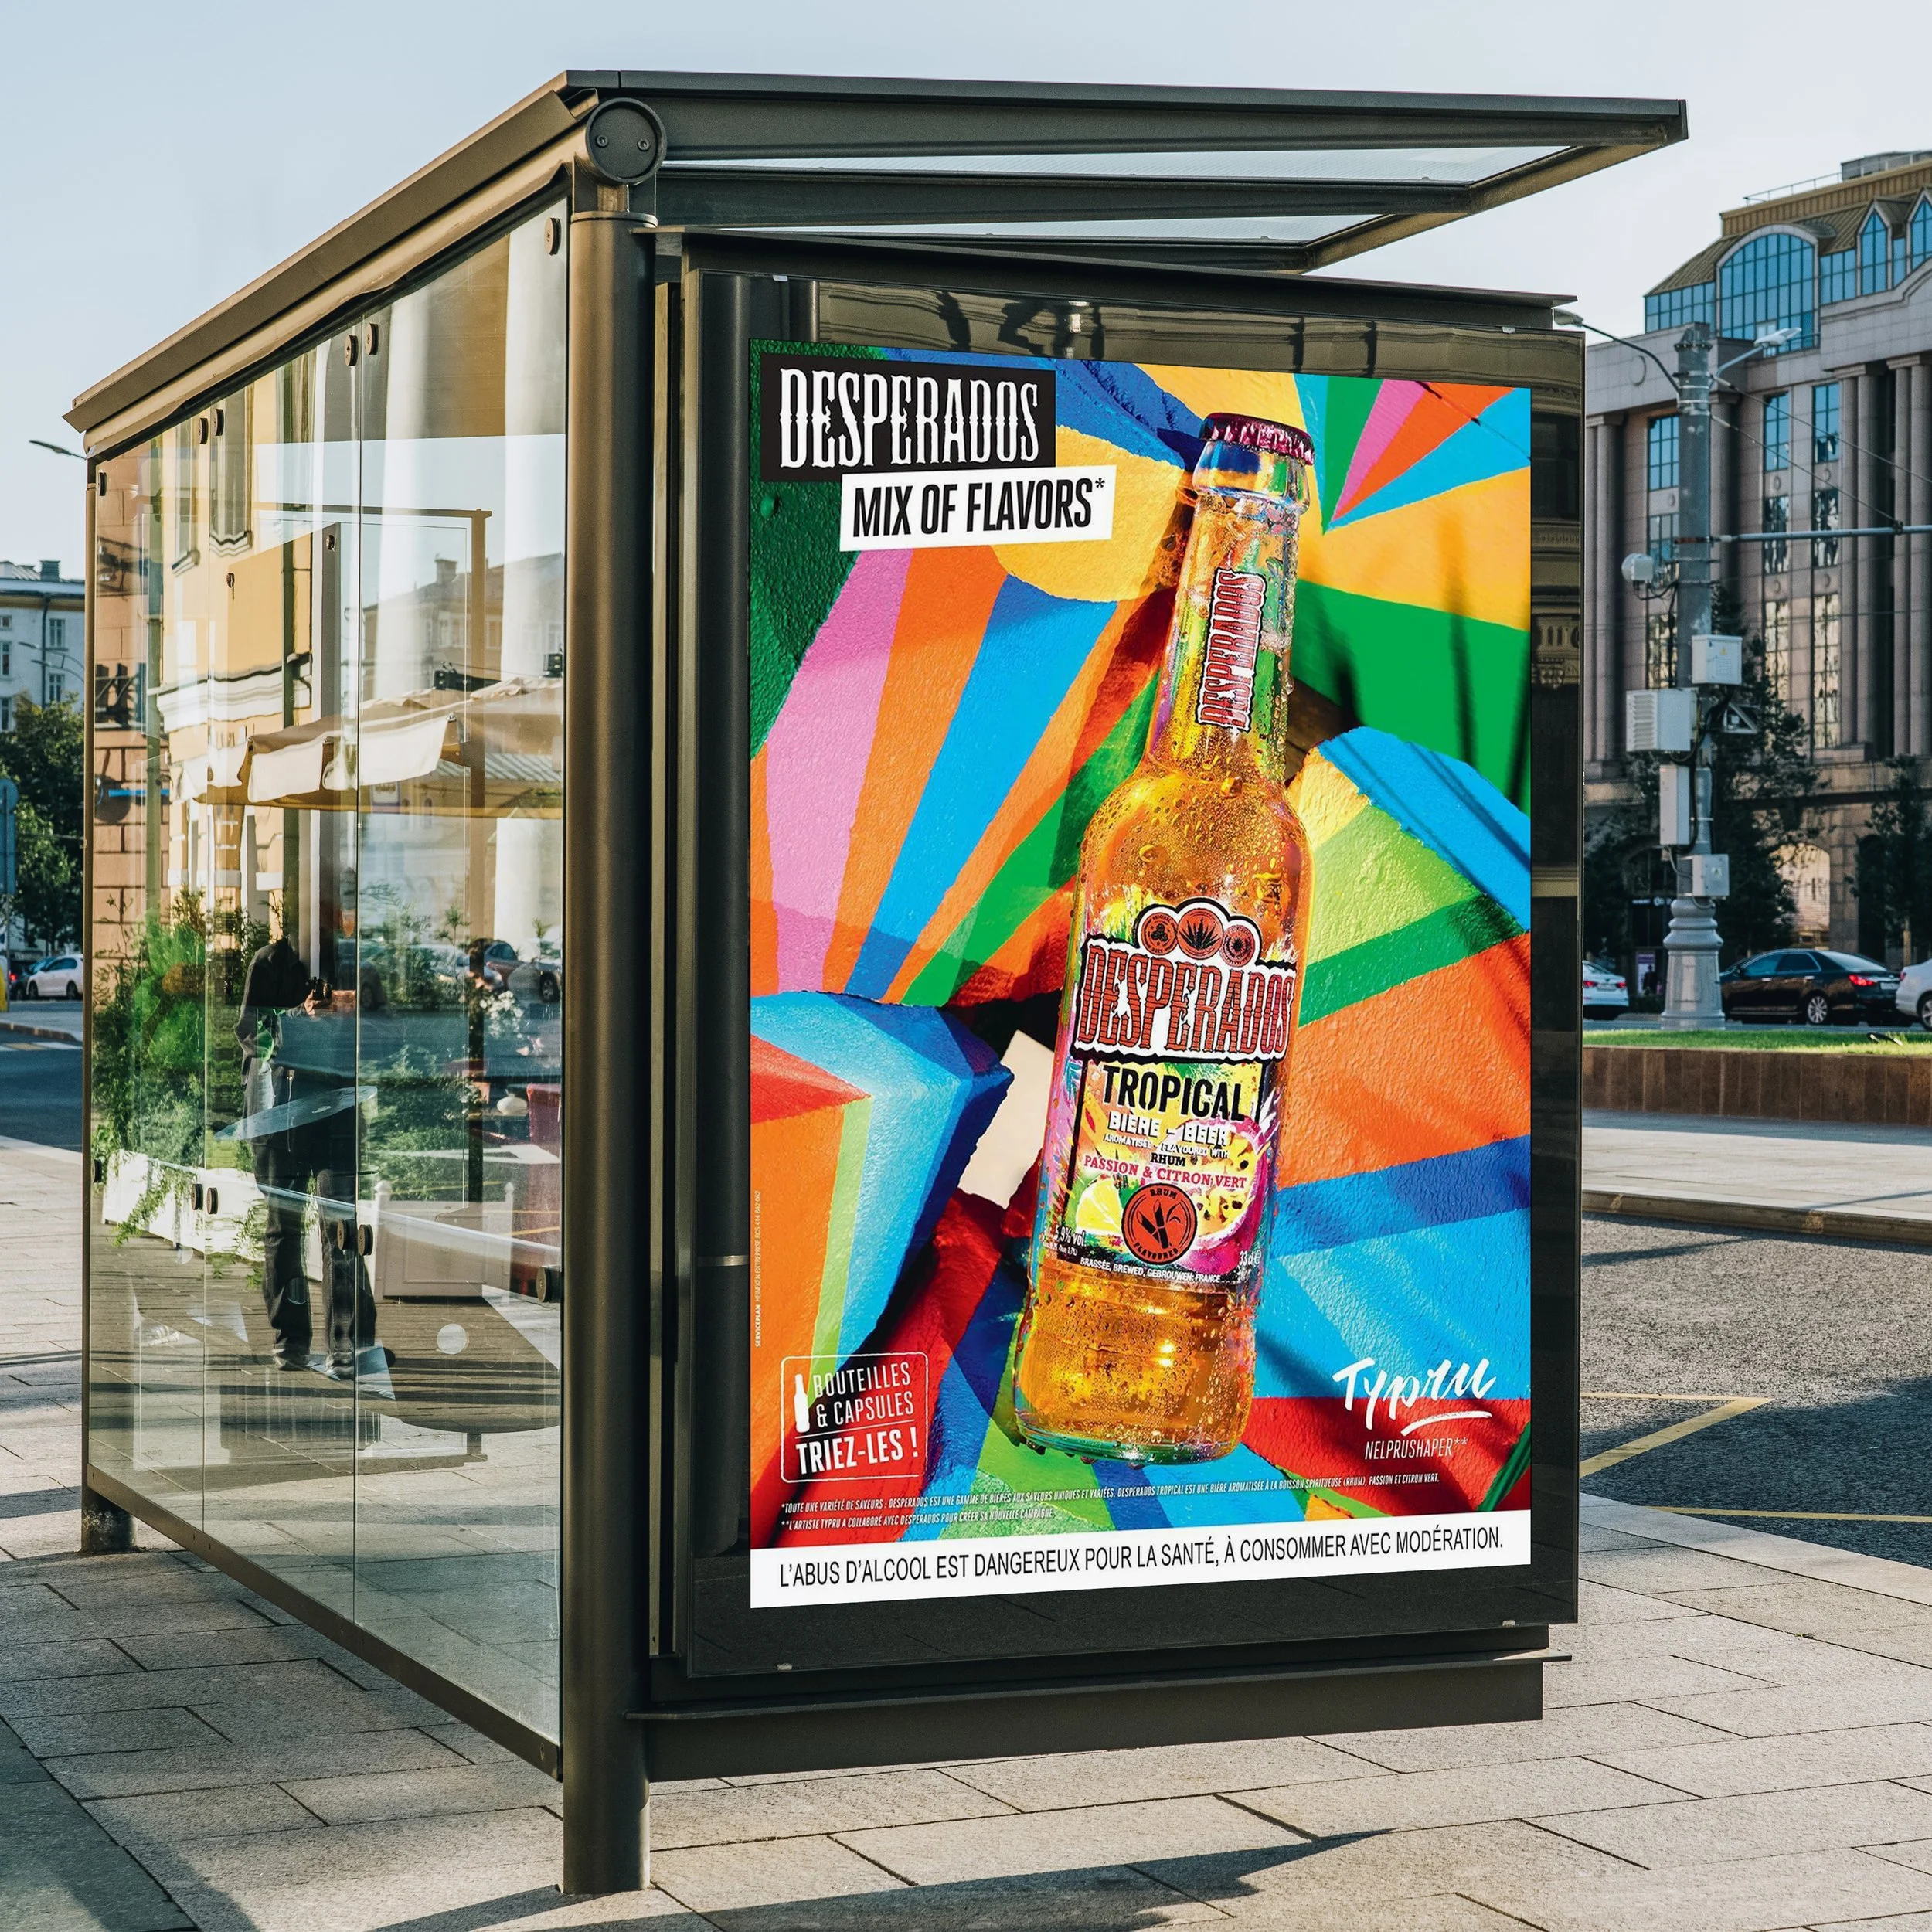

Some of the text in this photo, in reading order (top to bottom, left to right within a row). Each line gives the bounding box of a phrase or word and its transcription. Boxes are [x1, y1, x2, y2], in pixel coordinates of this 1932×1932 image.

[779, 368, 1039, 468] DESPERADOS
[853, 485, 913, 537] MIX
[921, 485, 957, 534] OF
[1200, 572, 1264, 728] DESPERADOS
[1077, 944, 1294, 1054] DESPERADOS
[1102, 1065, 1245, 1121] TROPICAL
[1182, 1124, 1230, 1147] BEER
[1083, 1155, 1247, 1189] PASSION & CITRON VERT
[1150, 1153, 1185, 1166] RHUM
[1150, 1188, 1178, 1199] RHUM
[1073, 1230, 1087, 1247] vol.
[1080, 1257, 1111, 1272] BRASSÉE,
[1113, 1264, 1145, 1277] BREWED,
[1196, 1274, 1221, 1283] FRANCE
[813, 1362, 911, 1399] BOUTEILLES
[816, 1391, 914, 1428] & CAPSULES
[796, 1427, 918, 1475] TRIEZ-LES !
[805, 1502, 818, 1512] UNE
[819, 1499, 845, 1512] VARIÉTÉ
[846, 1500, 854, 1510] DE
[855, 1498, 883, 1510] SAVEURS
[889, 1496, 928, 1508] DESPERADOS
[930, 1495, 941, 1506] EST
[942, 1495, 954, 1506] UNE
[956, 1495, 978, 1505] GAMME
[981, 1494, 988, 1505] DE
[1012, 1492, 1025, 1502] AUX
[1026, 1491, 1052, 1502] SAVEURS
[1054, 1489, 1080, 1501] UNIQUES
[1081, 1488, 1089, 1499] ET
[1090, 1486, 1116, 1498] VARIÉES.
[1117, 1485, 1155, 1498] DESPERADOS
[1156, 1484, 1184, 1495] TROPICAL
[1185, 1484, 1196, 1495] EST
[1197, 1483, 1209, 1494] UNE
[1209, 1481, 1227, 1493] BIÈRE
[1228, 1478, 1264, 1492] AROMATISÉE
[1264, 1478, 1270, 1490] À
[1270, 1480, 1277, 1490] LA
[1279, 1478, 1304, 1490] BOISSON
[1305, 1477, 1342, 1488] SPIRITUEUSE
[1343, 1476, 1367, 1488] (RHUM),
[1369, 1474, 1393, 1485] PASSION
[1394, 1474, 1401, 1484] ET
[1402, 1473, 1423, 1484] CITRON
[1423, 1472, 1440, 1483] VERT.
[821, 1518, 841, 1529] TYPRU
[842, 1518, 849, 1528] A
[848, 1514, 882, 1528] COLLABORÉ
[883, 1515, 899, 1526] AVEC
[900, 1512, 940, 1526] DESPERADOS
[940, 1512, 958, 1523] POUR
[980, 1511, 988, 1521] SA
[989, 1509, 1019, 1521] NOUVELLE
[780, 1526, 1503, 1587] L'ABUS D'ALCOOL EST DANGEREUX POUR LA SANTÉ, À CONSOMMER AVEC MODÉRATION.
